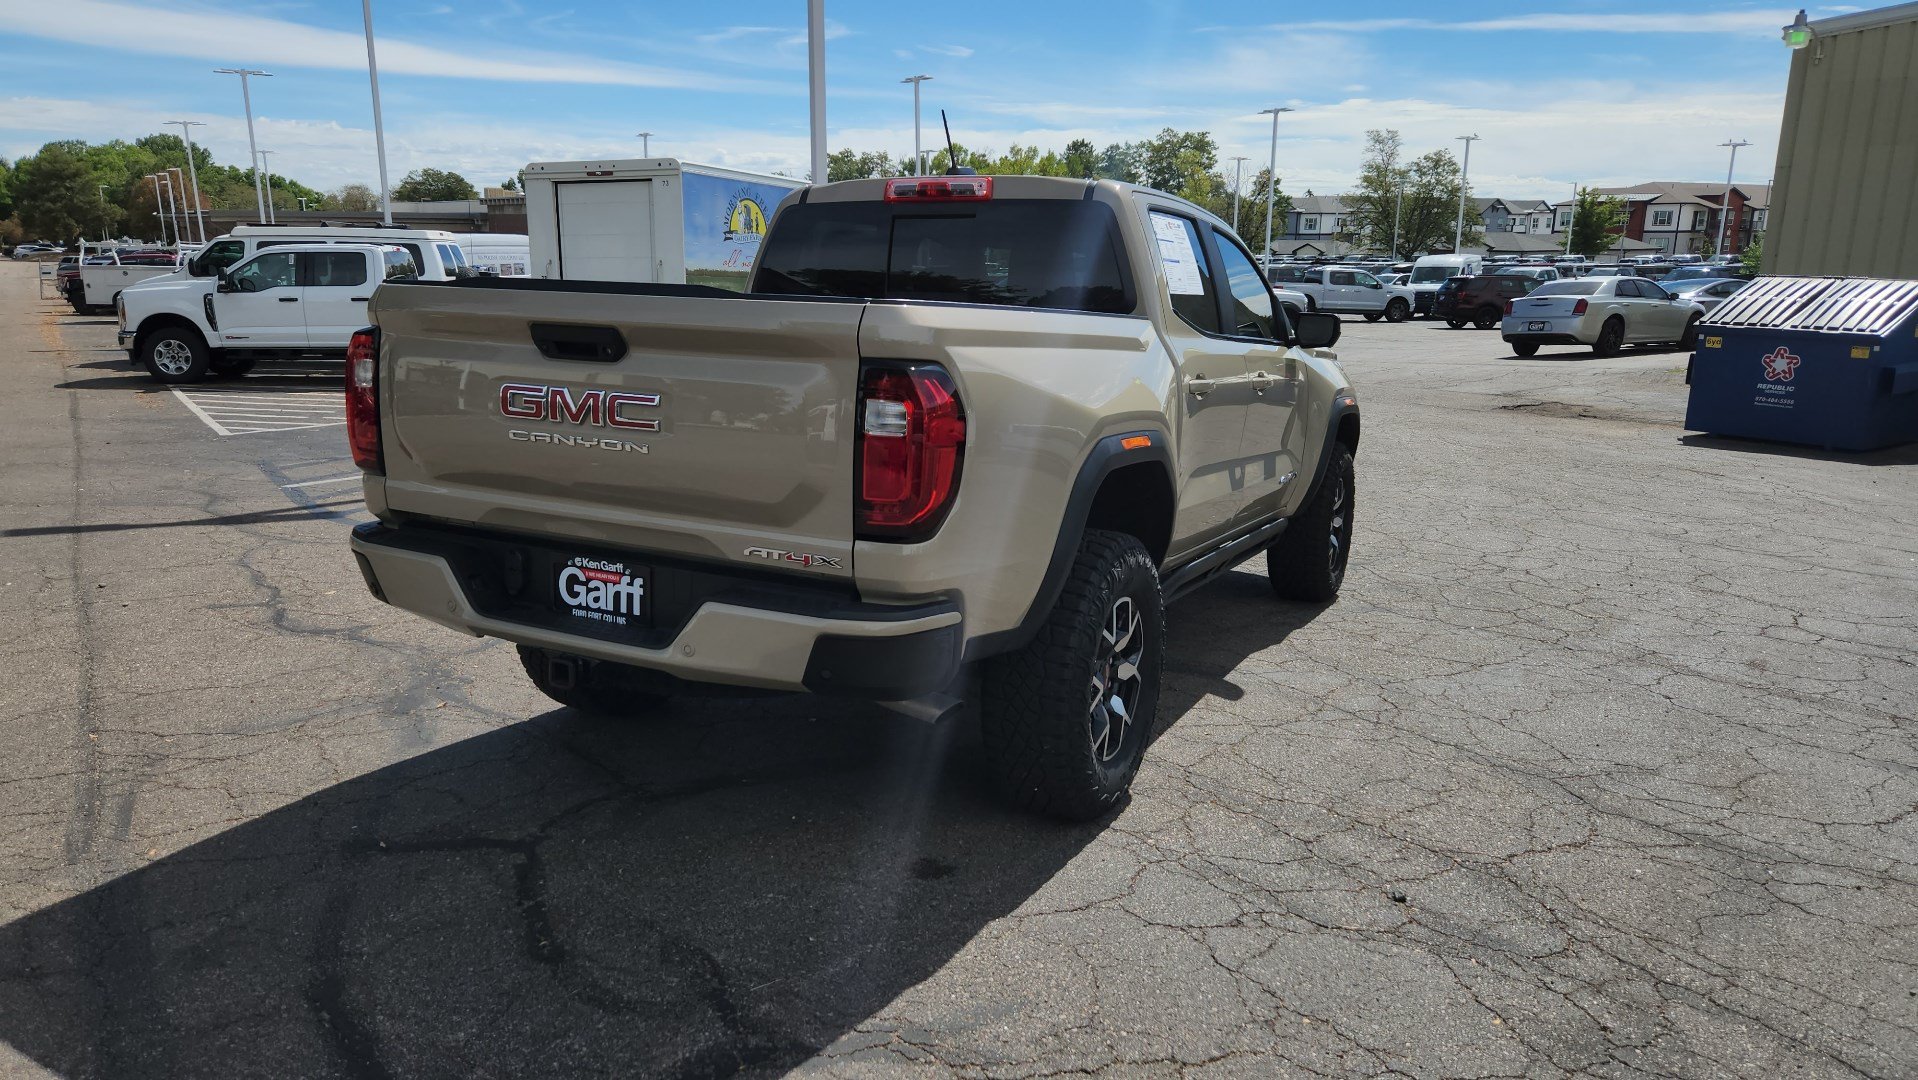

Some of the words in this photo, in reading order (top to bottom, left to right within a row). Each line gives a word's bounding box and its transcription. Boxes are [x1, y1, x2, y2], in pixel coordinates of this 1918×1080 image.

[723, 186, 752, 228] MORNING
[1707, 338, 1721, 346] 6yd
[1757, 383, 1795, 391] REPUBLIC
[500, 383, 661, 432] GMC
[508, 429, 650, 454] CANYON
[582, 557, 600, 569] Ken
[600, 560, 624, 574] Garff
[743, 546, 843, 569] AT4X
[558, 566, 644, 616] Garff
[587, 610, 602, 620] FORT
